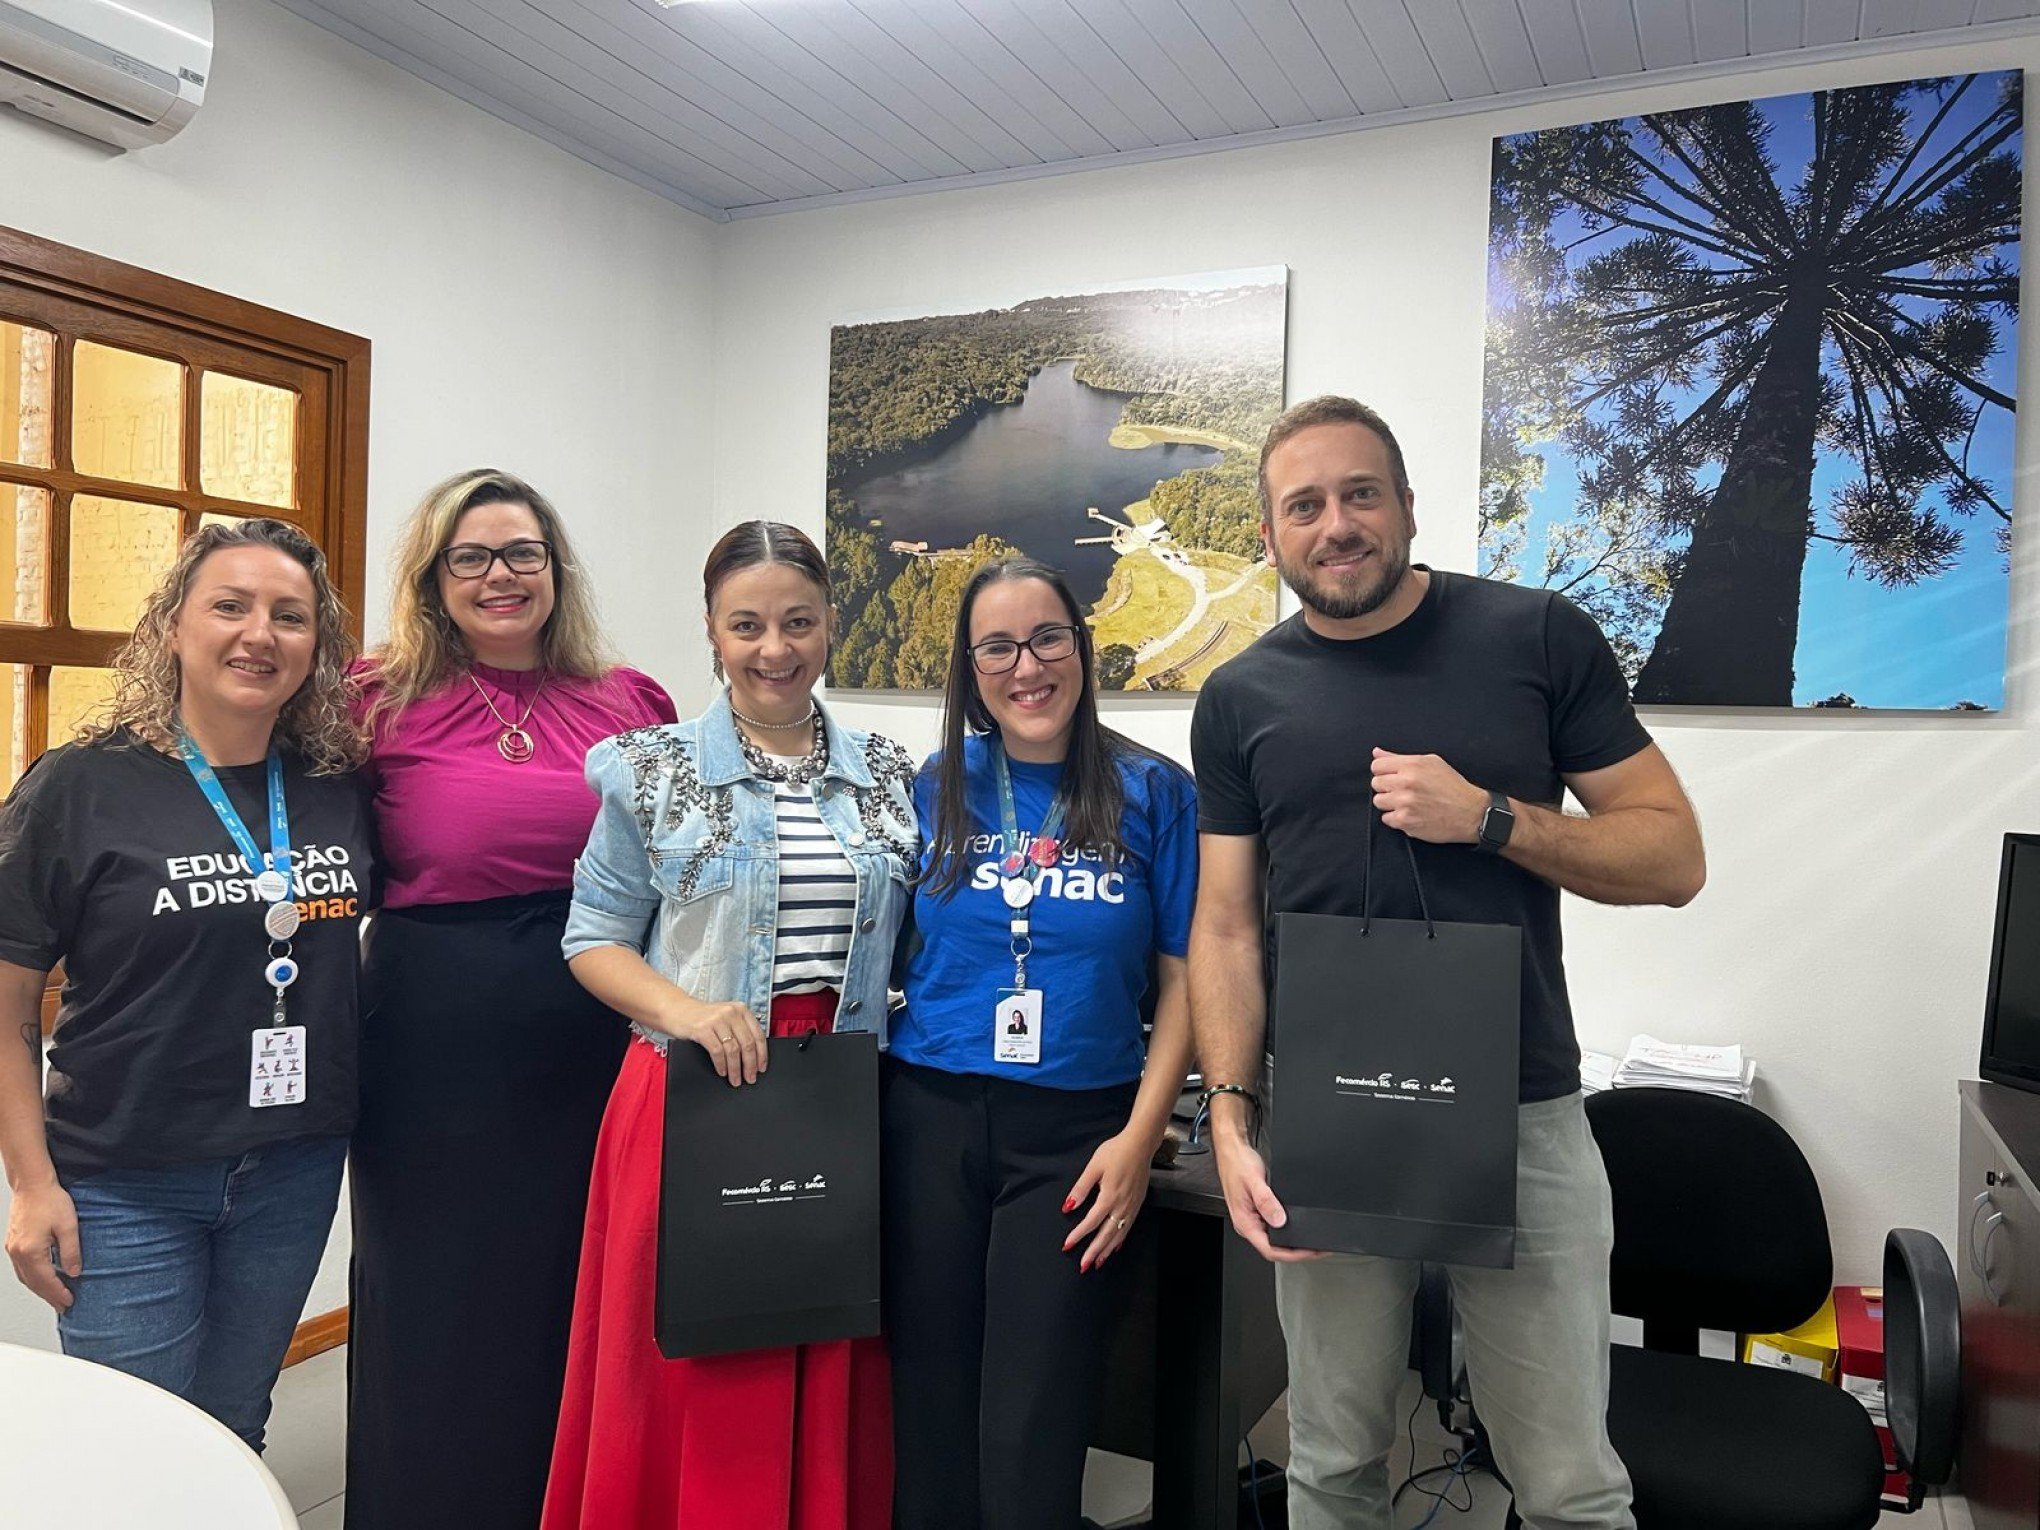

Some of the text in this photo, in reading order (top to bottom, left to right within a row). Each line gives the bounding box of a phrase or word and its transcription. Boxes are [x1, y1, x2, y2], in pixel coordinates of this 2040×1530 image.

[926, 829, 1125, 867] renigem
[152, 869, 358, 916] A DISTNCIA
[971, 861, 1124, 904] snac
[296, 898, 358, 923] enac
